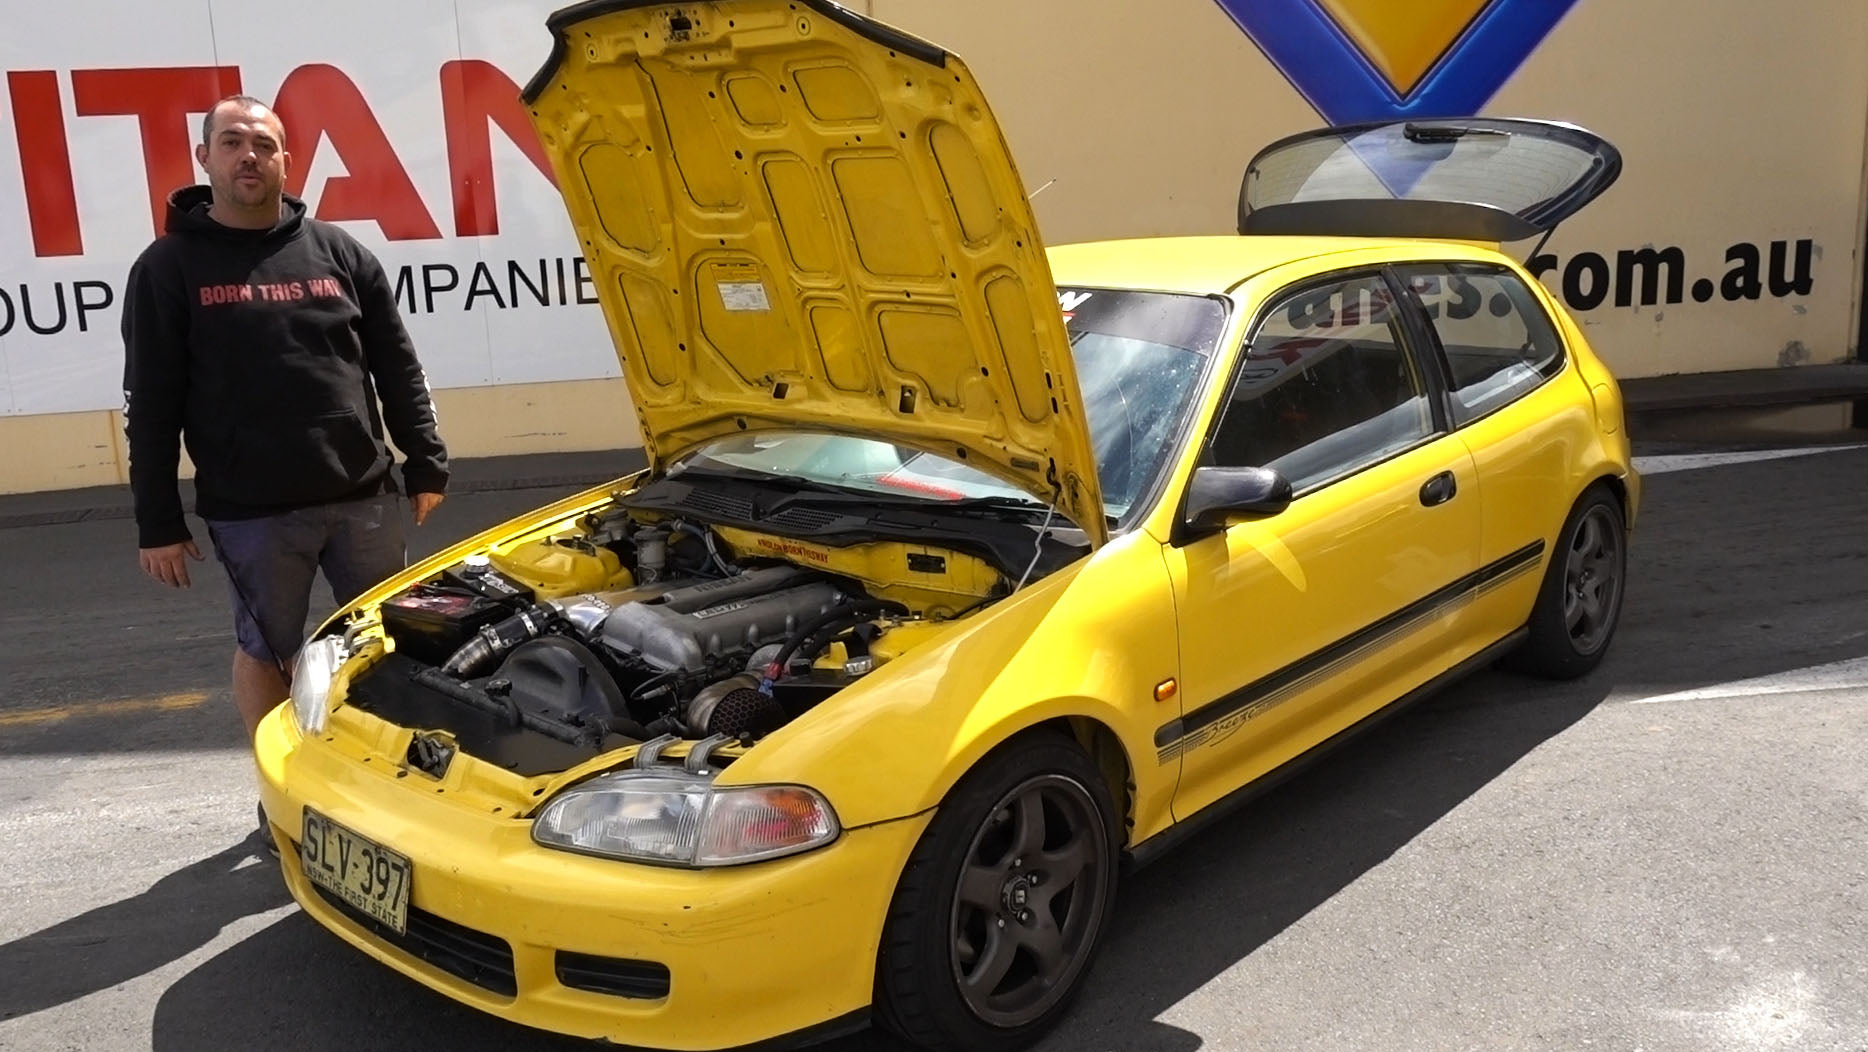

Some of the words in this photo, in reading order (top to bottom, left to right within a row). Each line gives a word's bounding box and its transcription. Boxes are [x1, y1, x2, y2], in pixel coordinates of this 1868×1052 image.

[200, 284, 253, 306] BORN
[257, 281, 304, 301] THIS
[370, 902, 399, 929] STATE
